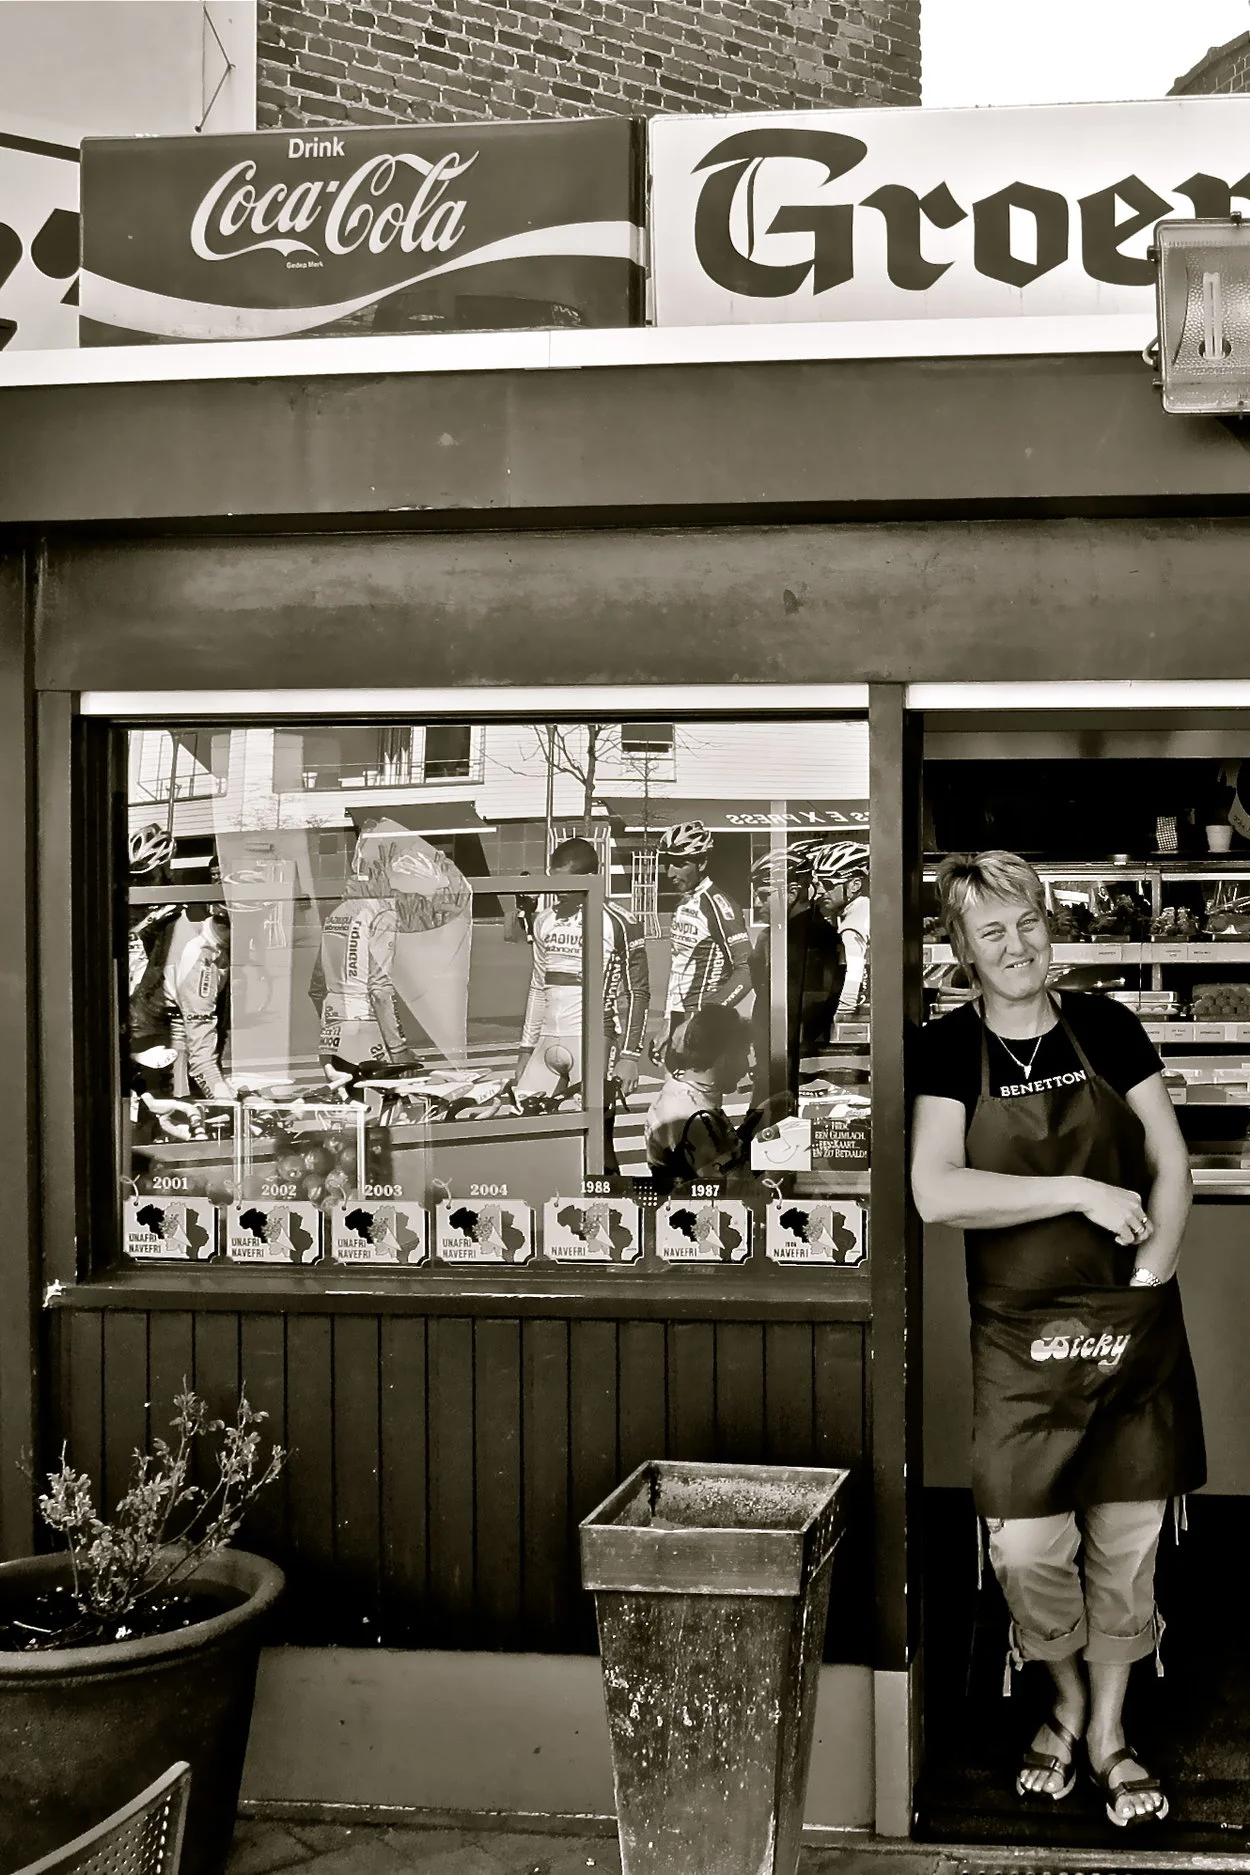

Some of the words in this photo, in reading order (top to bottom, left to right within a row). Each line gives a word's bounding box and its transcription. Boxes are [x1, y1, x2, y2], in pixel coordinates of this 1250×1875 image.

[288, 136, 345, 159] Drink
[190, 150, 480, 261] Coca-Cola
[1000, 1069, 1087, 1097] BENETTON
[152, 1177, 188, 1190] 2001
[580, 1181, 611, 1194] 1988
[261, 1184, 297, 1197] 2002
[364, 1184, 403, 1197] 2003
[470, 1183, 508, 1197] 2004
[691, 1184, 720, 1197] 1987
[129, 1233, 157, 1242] UNAFRI
[231, 1237, 260, 1247] UNAFRI
[443, 1238, 472, 1247] UNAFRI
[337, 1238, 366, 1248] UNAFRI
[129, 1244, 161, 1253] NAVEFRI
[231, 1248, 264, 1258] NAVEFRI
[443, 1249, 477, 1258] NAVEFRI
[551, 1246, 586, 1257] NAVEFRI
[663, 1247, 697, 1257] NAVEFRI
[773, 1248, 809, 1257] NAVEFRI
[337, 1249, 371, 1259] NAVEFRI
